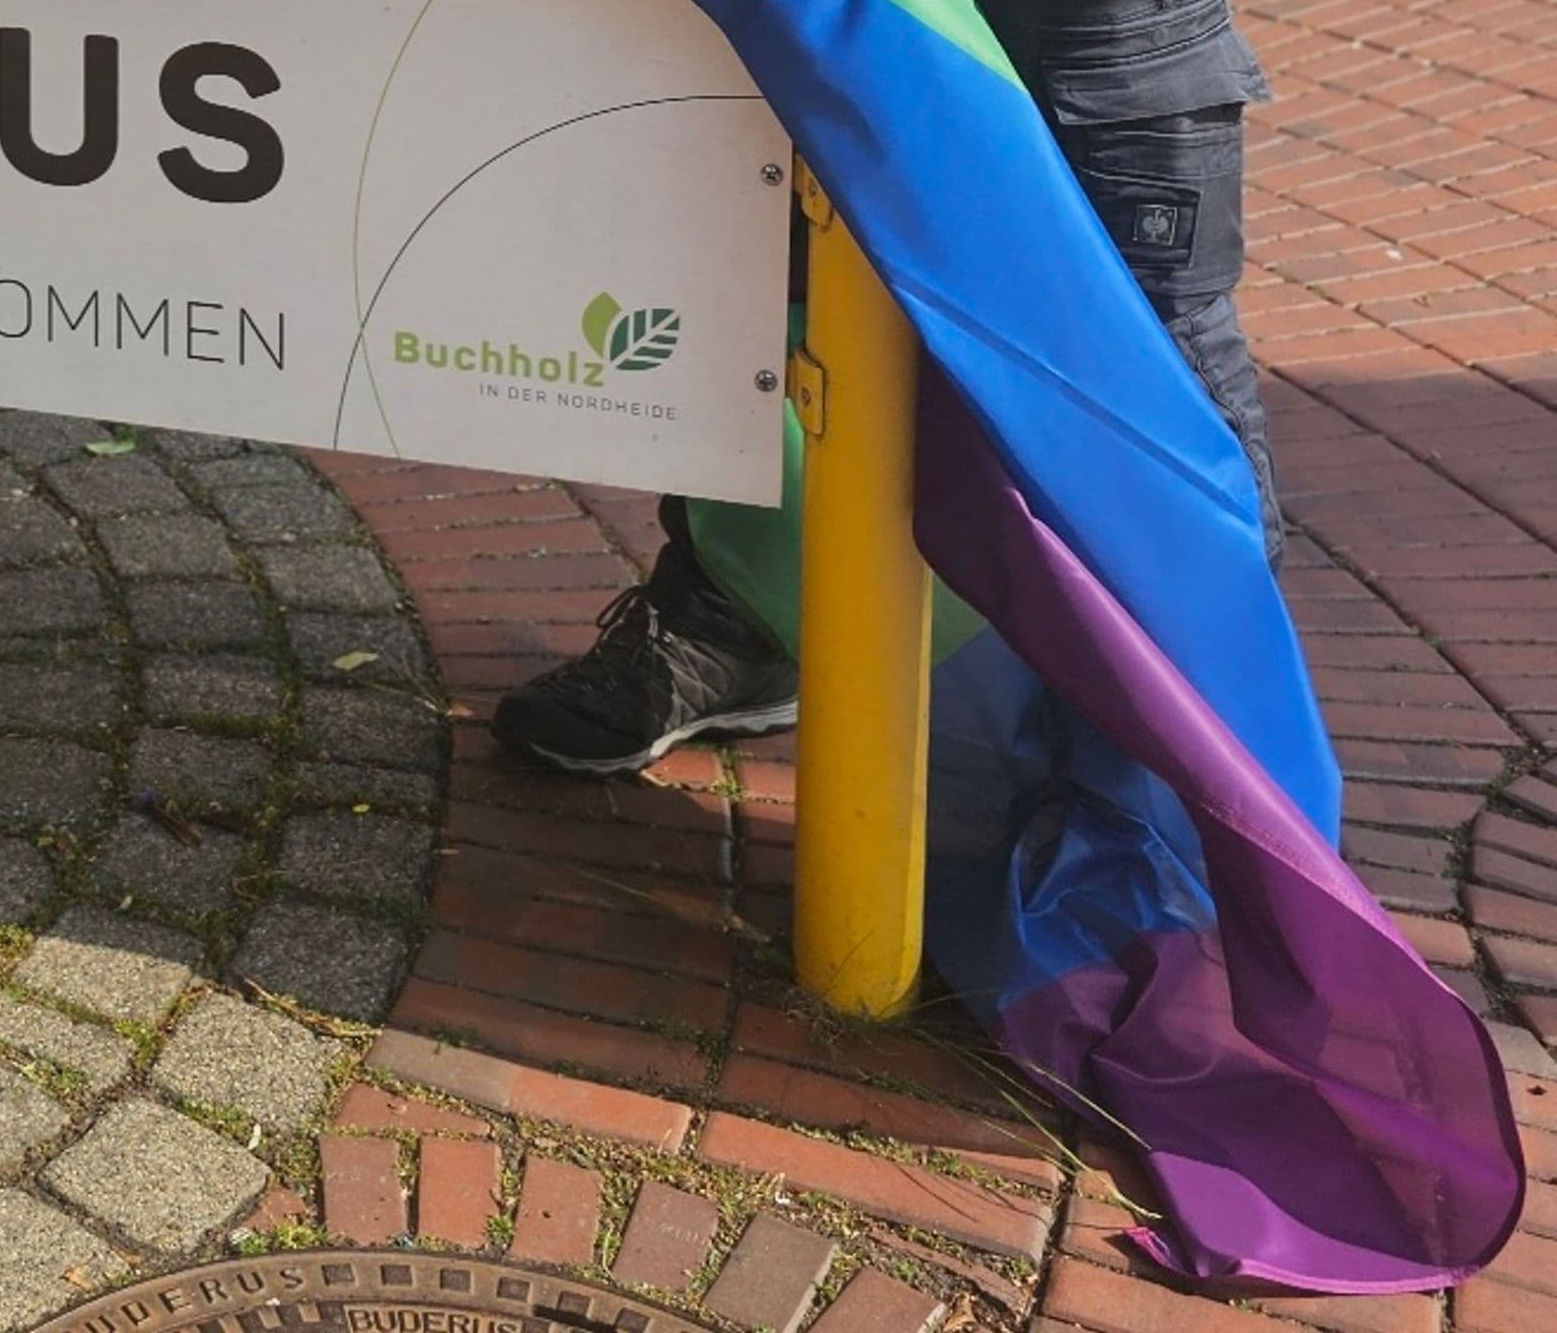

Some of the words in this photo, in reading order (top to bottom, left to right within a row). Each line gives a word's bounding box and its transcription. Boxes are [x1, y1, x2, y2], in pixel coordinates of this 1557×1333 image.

[394, 331, 605, 387] Buchholz
[478, 382, 499, 397] IN
[507, 385, 547, 403] DER
[557, 392, 678, 421] NORDHEIDE
[59, 1266, 304, 1333] UDERUS
